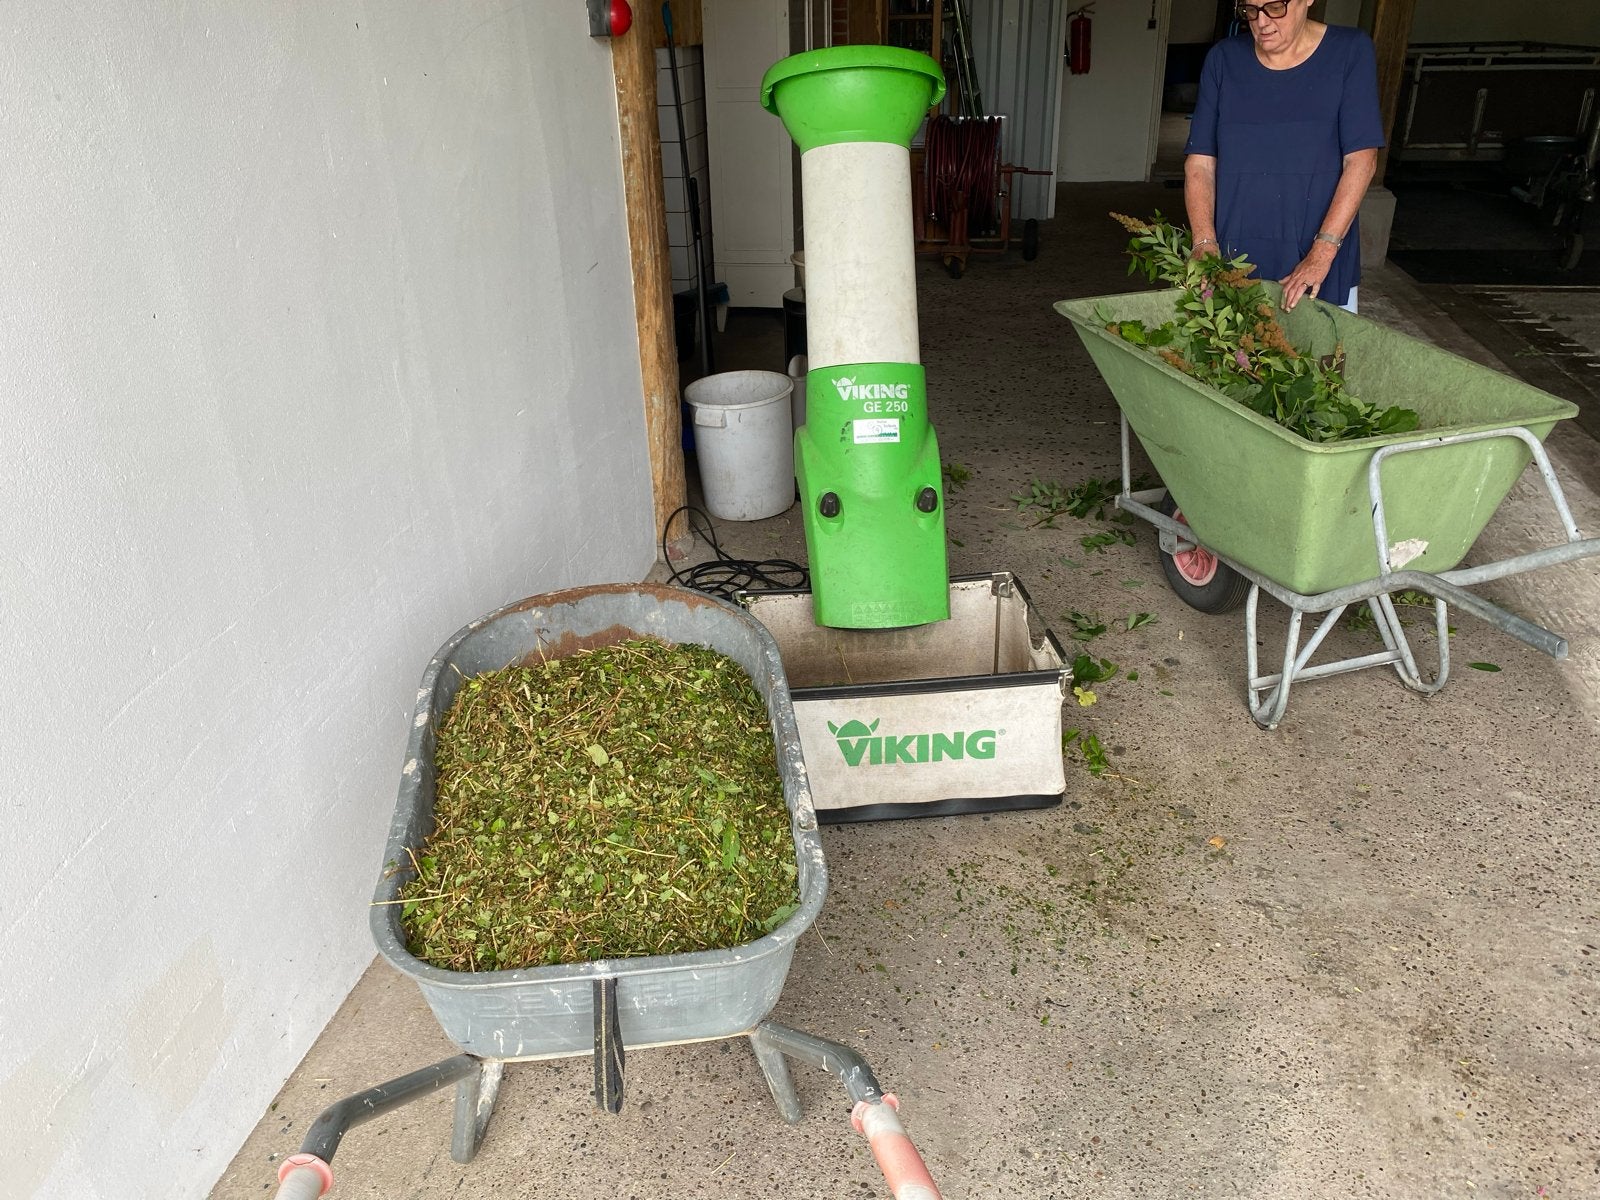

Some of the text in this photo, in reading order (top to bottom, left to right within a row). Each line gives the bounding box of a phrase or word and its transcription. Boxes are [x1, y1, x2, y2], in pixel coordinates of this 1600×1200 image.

[837, 384, 908, 400] VIKING
[863, 401, 908, 412] GE 250
[836, 729, 997, 767] VIKING
